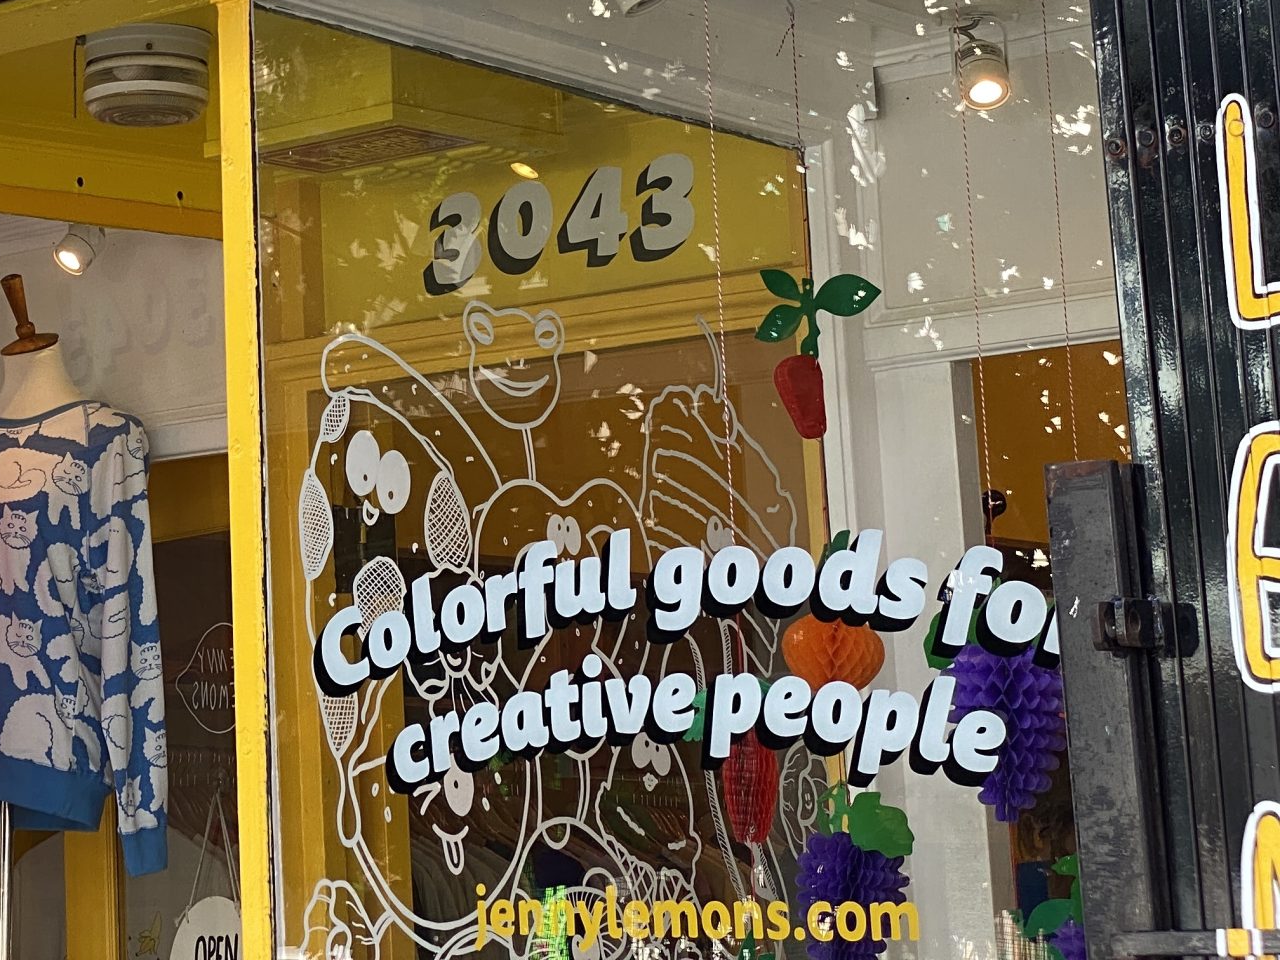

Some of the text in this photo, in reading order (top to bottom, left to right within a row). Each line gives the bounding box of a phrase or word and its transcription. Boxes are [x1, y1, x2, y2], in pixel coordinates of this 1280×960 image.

[422, 152, 696, 297] 3043
[314, 528, 1061, 695] Colorful goods fo
[388, 652, 1008, 794] creative people
[474, 883, 919, 951] jennylemons.com
